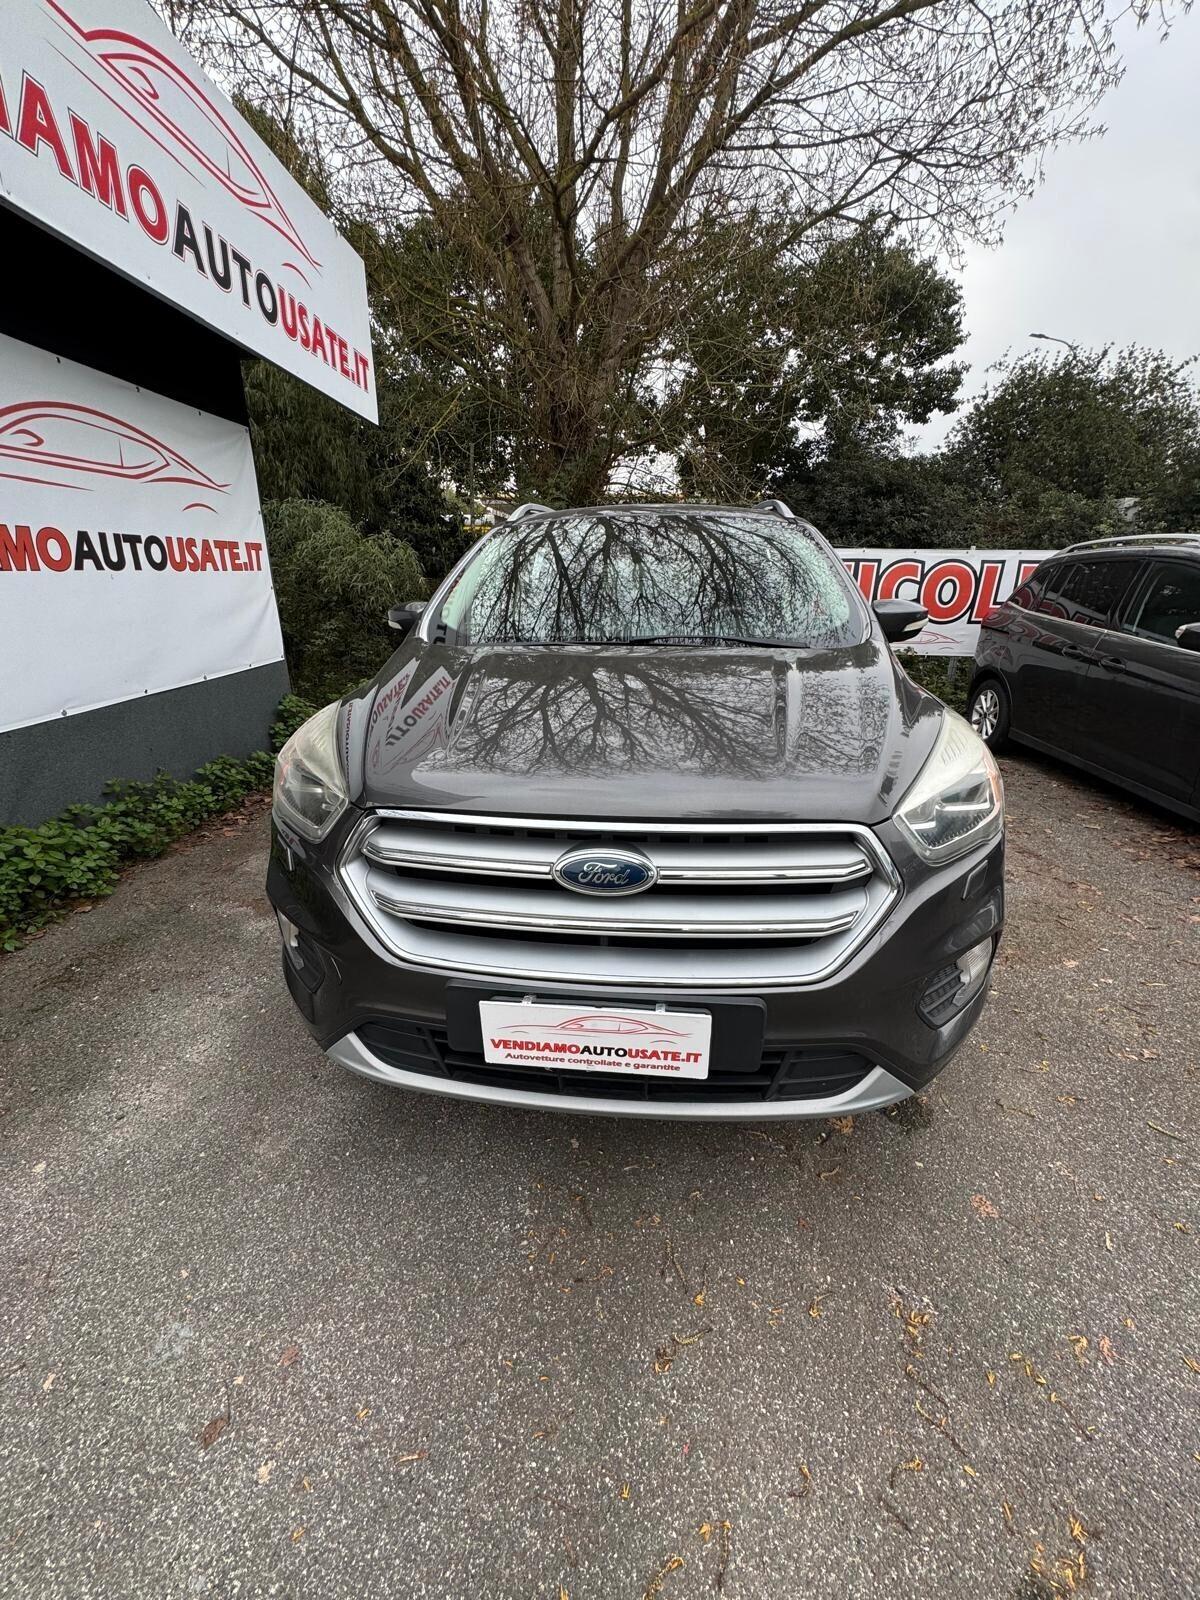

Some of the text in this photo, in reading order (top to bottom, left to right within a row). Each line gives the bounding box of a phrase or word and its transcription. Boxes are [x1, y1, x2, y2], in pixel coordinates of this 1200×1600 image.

[841, 558, 1043, 624] ICOL
[578, 862, 631, 885] Ford
[490, 1038, 702, 1063] VENDIAMOAUTOUSATE.IT
[505, 1052, 566, 1063] Autovetture
[567, 1057, 622, 1067] controllate
[633, 1062, 681, 1071] garantite
